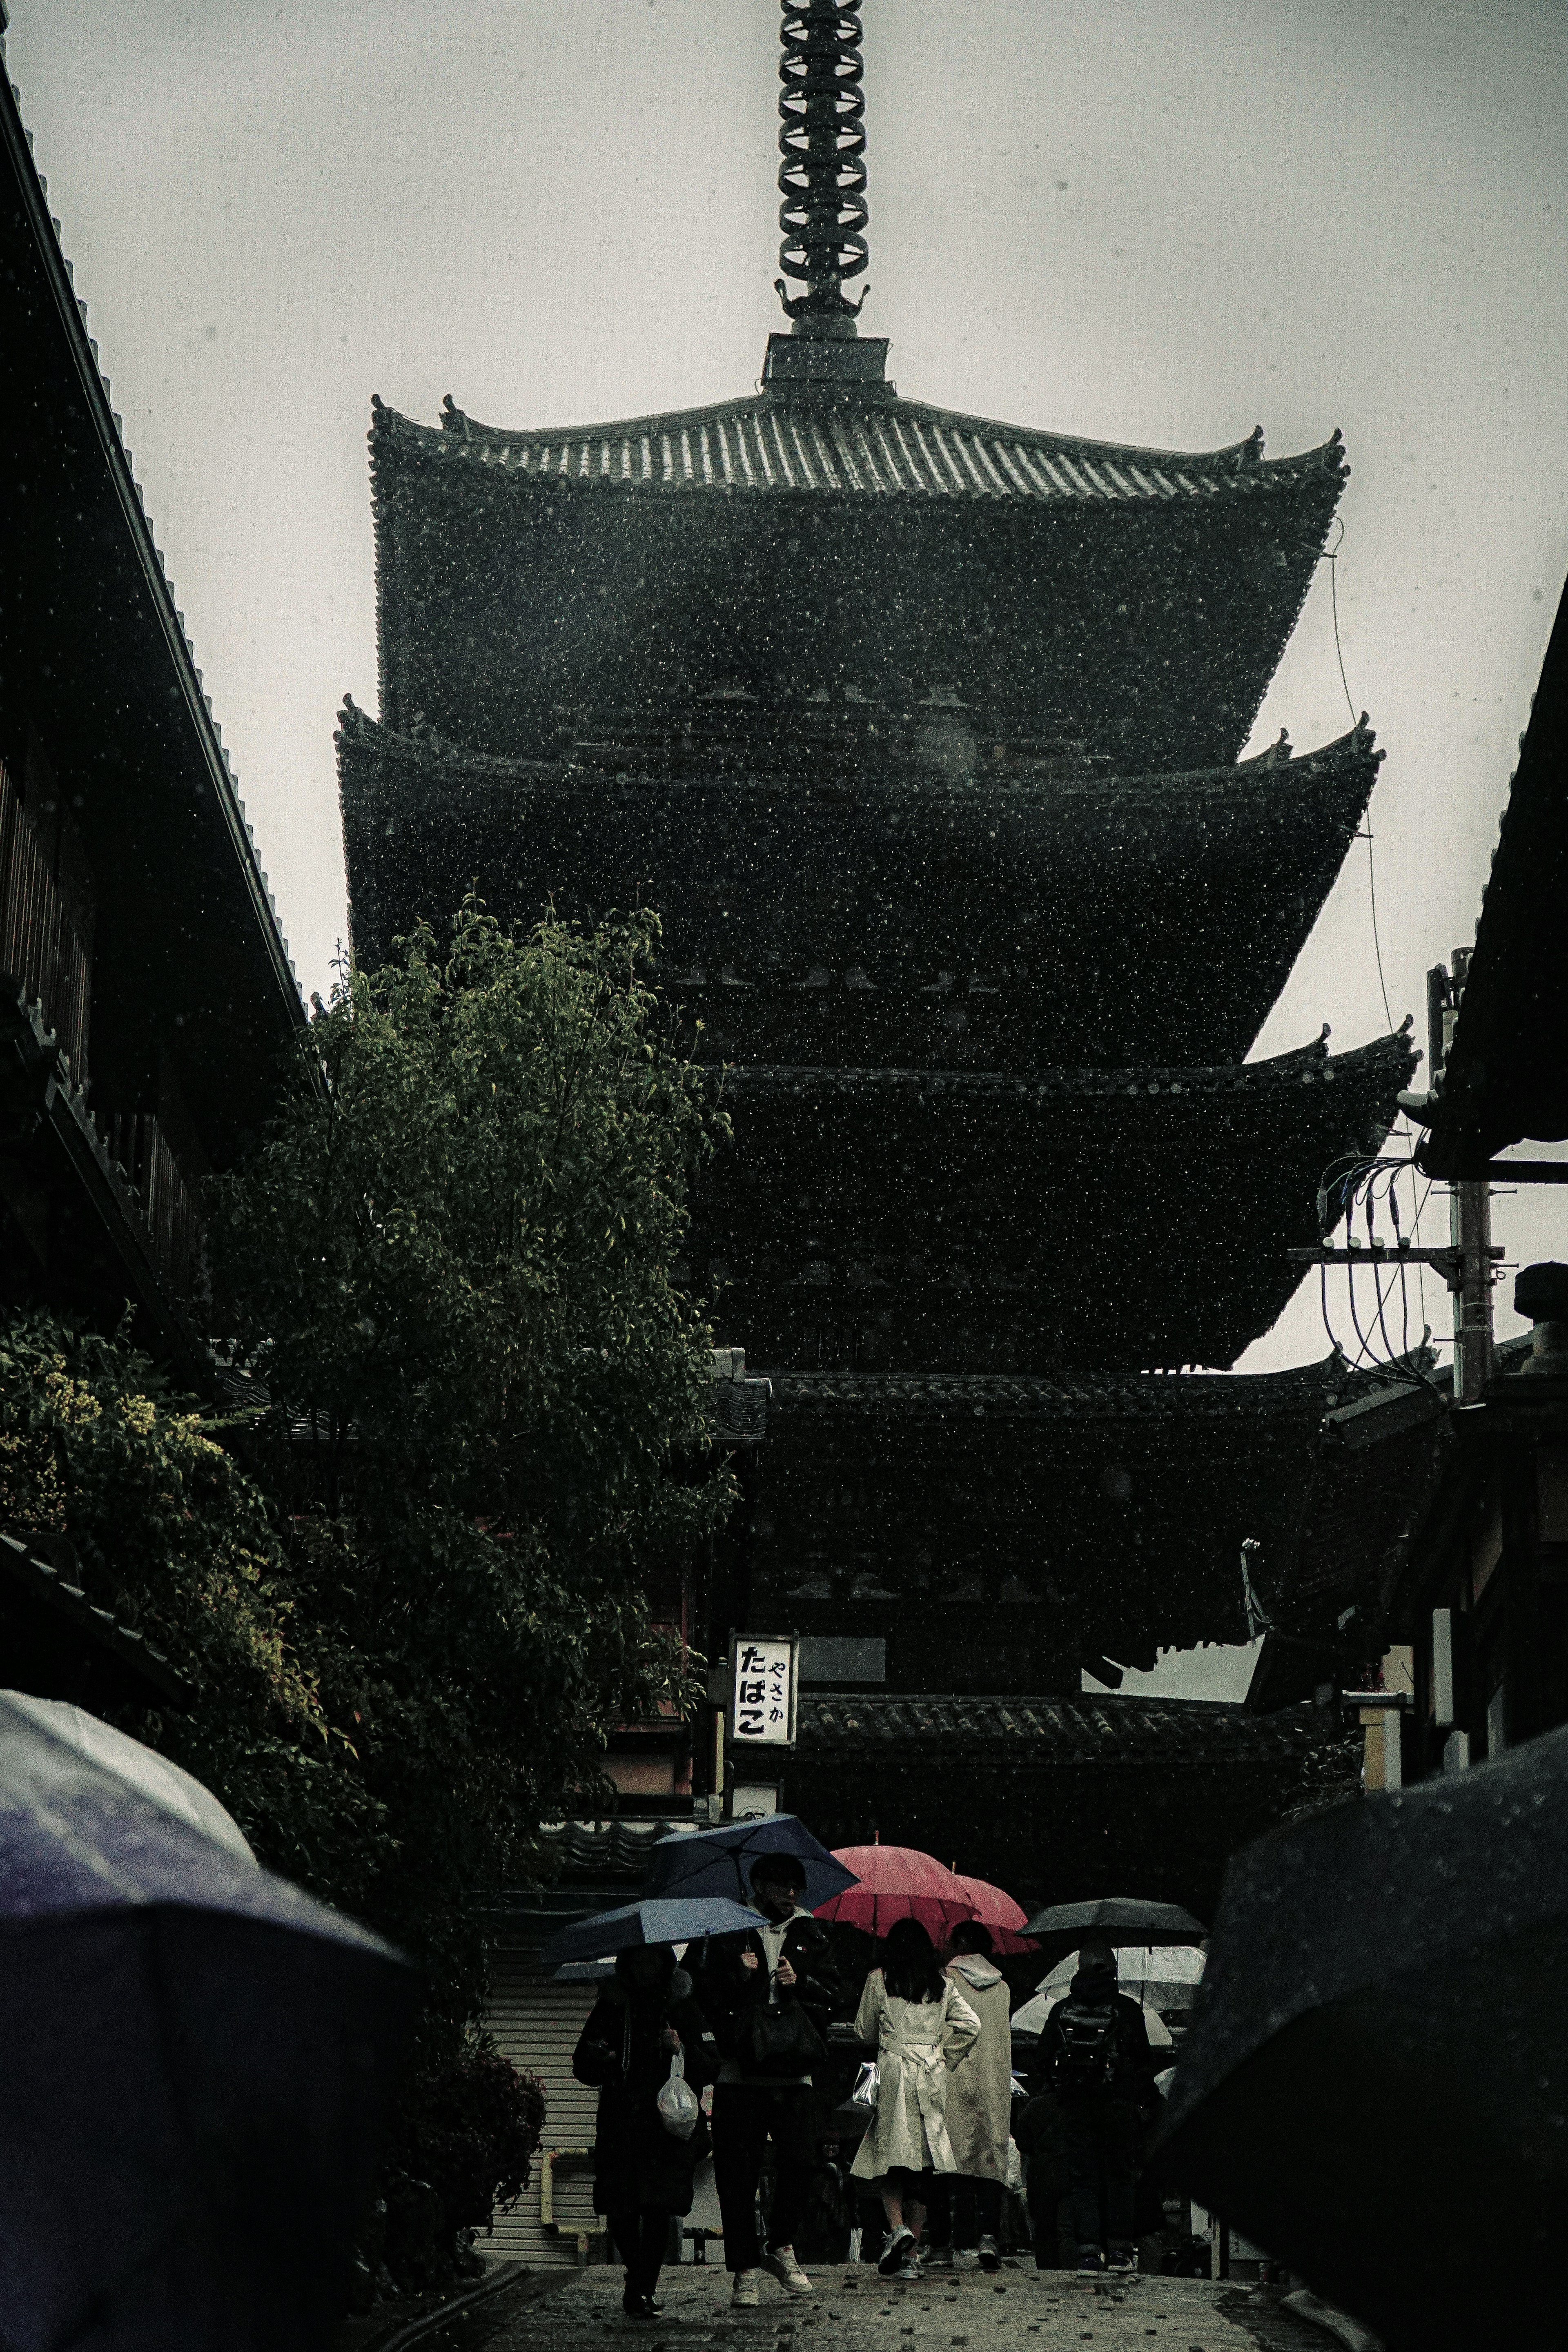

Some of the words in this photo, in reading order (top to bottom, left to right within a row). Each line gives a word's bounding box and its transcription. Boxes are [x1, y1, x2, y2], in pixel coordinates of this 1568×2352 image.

[738, 1647, 766, 1735] たばこ
[768, 1662, 786, 1723] やさか
